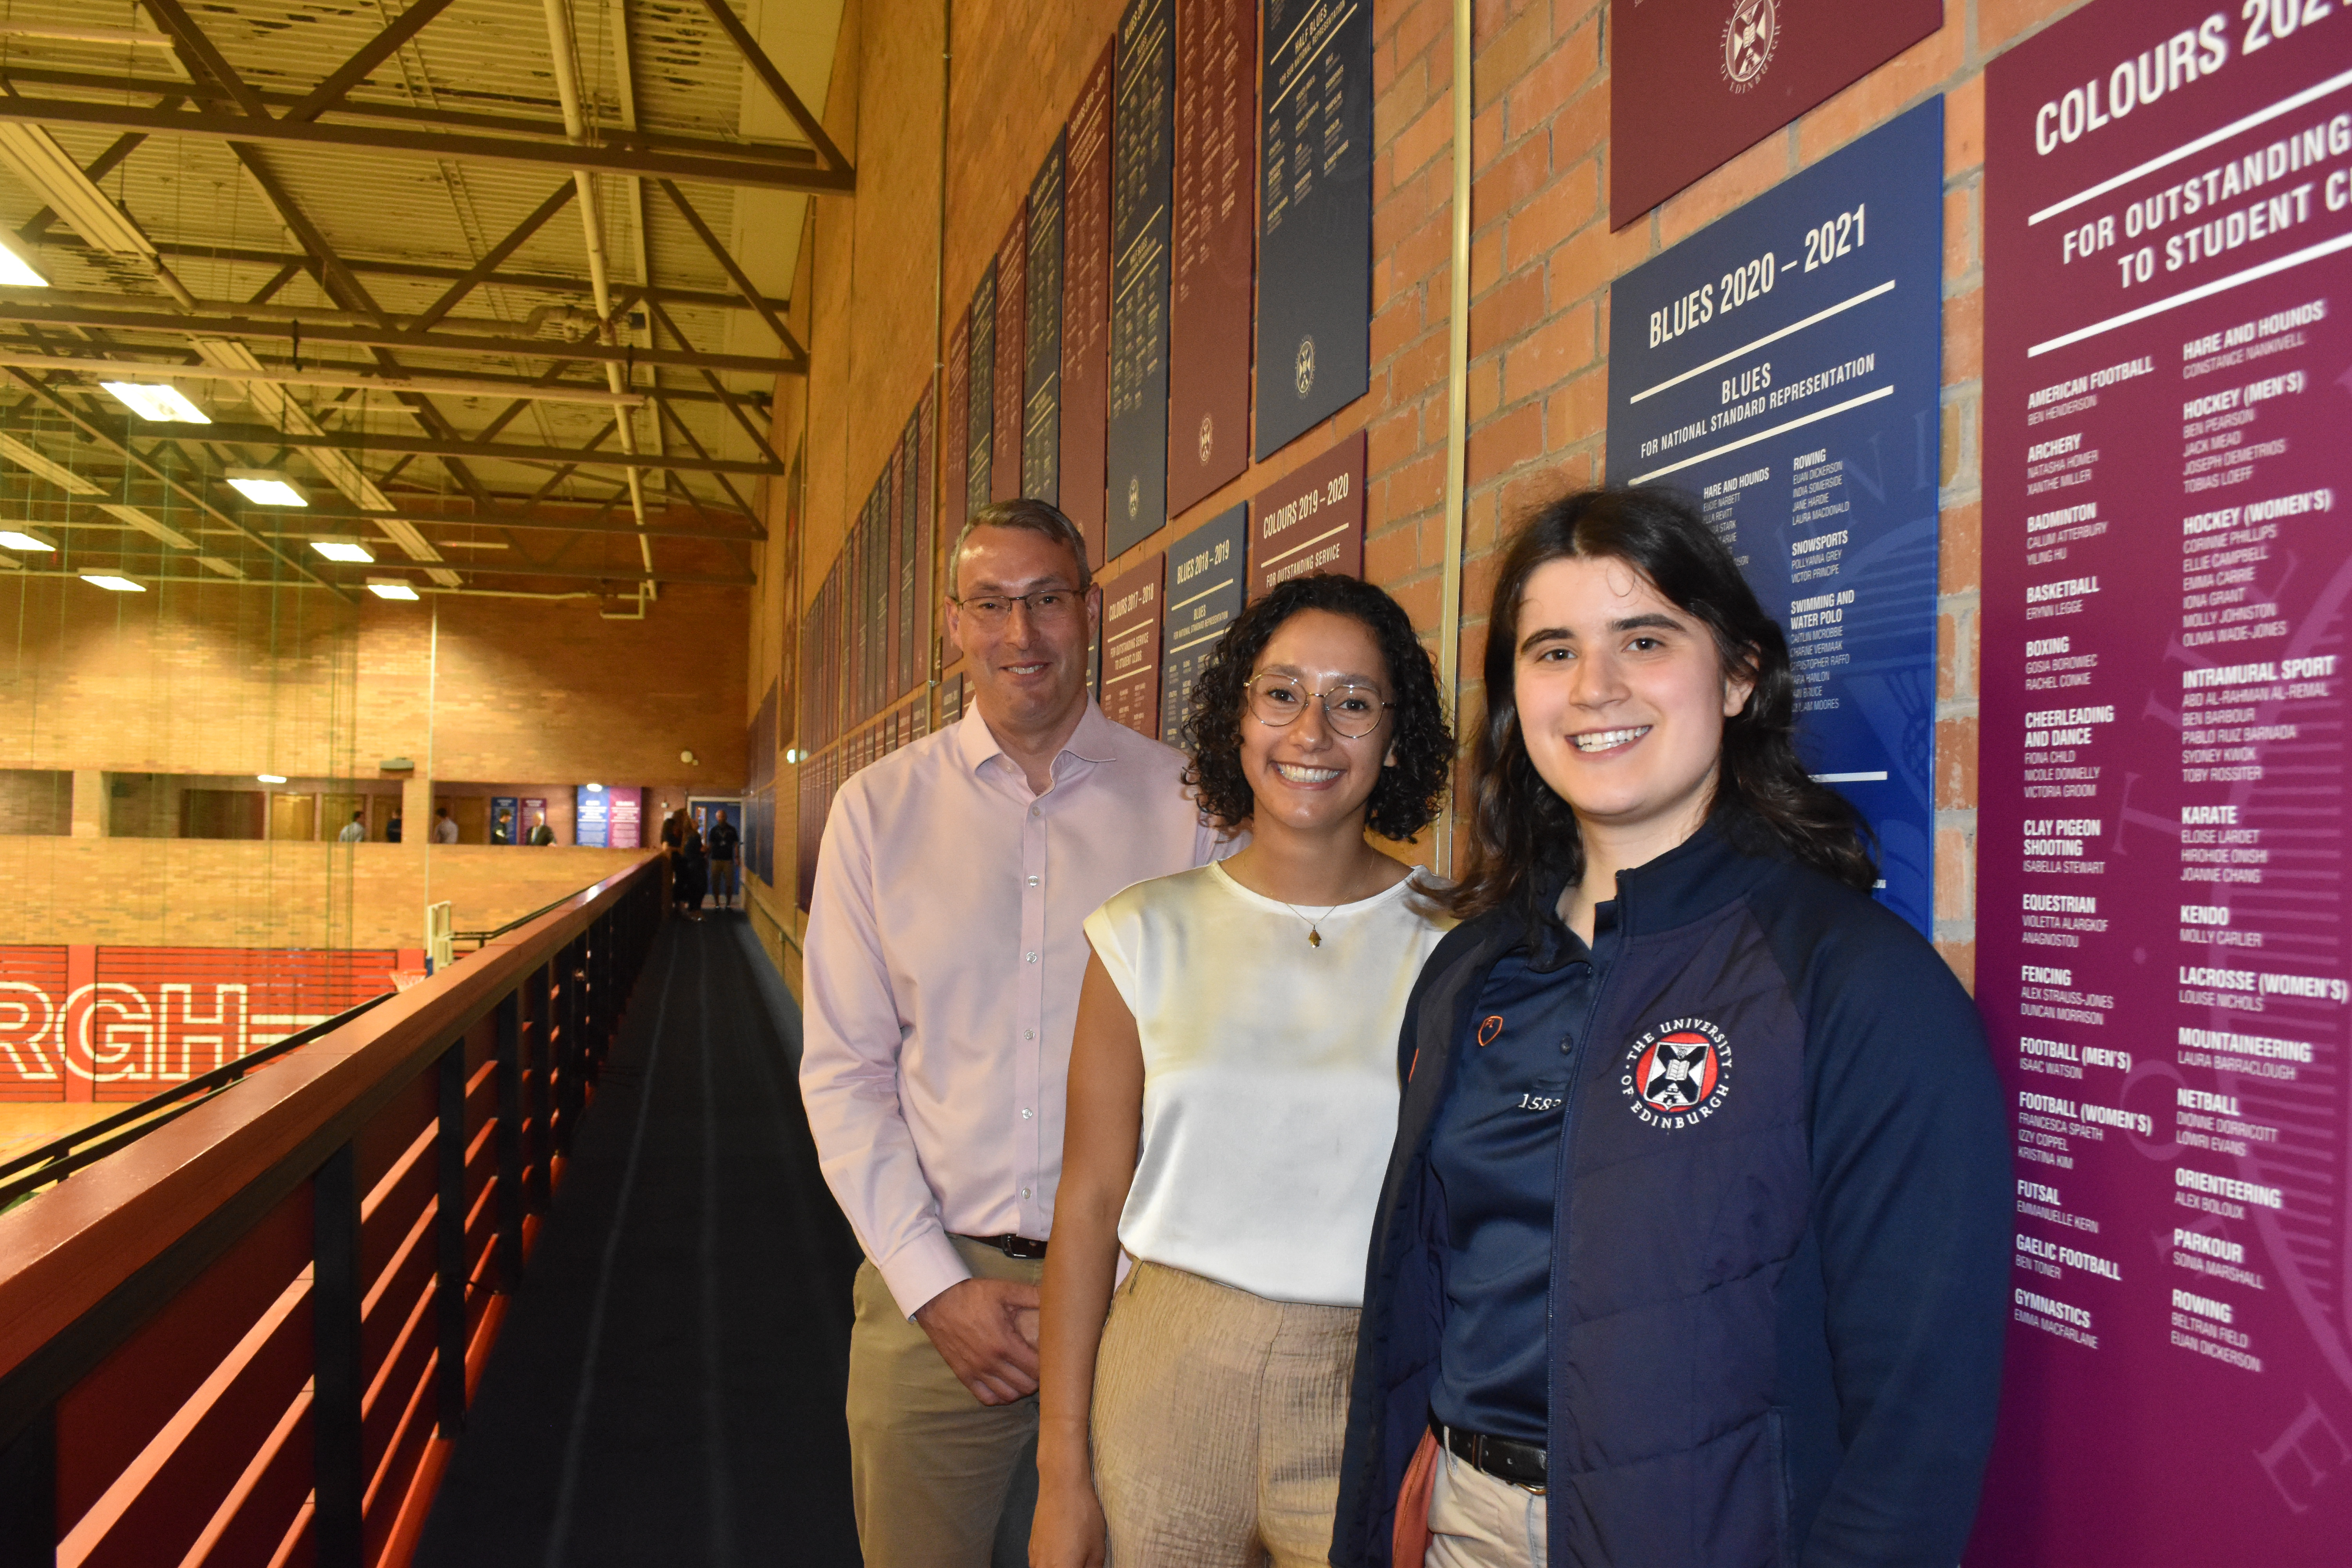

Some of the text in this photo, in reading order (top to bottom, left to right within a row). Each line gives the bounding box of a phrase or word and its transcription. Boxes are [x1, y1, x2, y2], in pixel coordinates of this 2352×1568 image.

[1295, 4, 1327, 54] HALF BLUES
[2036, 13, 2227, 156] COLOURS
[2063, 113, 2352, 264] FOR OUTSTANDING
[2118, 183, 2313, 289] TO STUDENT
[1650, 283, 1713, 349] BLUES
[1720, 252, 1775, 314] 2020
[1804, 203, 1865, 273] 2021
[2183, 297, 2326, 363] HARE AND HOUNDS
[1722, 361, 1771, 405] BLUES
[2028, 352, 2154, 410] AMERICAN FOOTBALL
[2183, 367, 2306, 422] HOCKEY (MEN'S)
[1641, 352, 1875, 459] FOR NATIONAL STANDARD REPRESENTATION
[1793, 447, 1826, 472] ROWING
[2027, 431, 2082, 464] ARCHERY
[1704, 466, 1769, 500] HARE AND HOUNDS
[1793, 460, 1843, 485] EUAN DICKERSON
[1793, 474, 1843, 499] INDIA SOMERSIDE
[1263, 501, 1297, 539] COLOURS
[1299, 489, 1318, 520] 2019
[1327, 472, 1349, 506] 2020
[1792, 492, 1829, 512] JANE HARDIE
[1792, 500, 1850, 526] LAURA MACDONALD
[2027, 500, 2098, 534] BADMINTON
[2183, 486, 2332, 537] HOCKEY (WOMEN'S)
[1791, 548, 1842, 570] POLLYANNA GREY
[1792, 529, 1848, 557] SNOWSPORTS
[2183, 543, 2270, 574] ELLIE CAMPBELL
[1177, 558, 1194, 584] BLUES
[1195, 550, 1209, 575] 2018
[1214, 539, 1229, 565] 2019
[1267, 543, 1340, 588] FOR OUTSTANDING SERVICE
[1791, 563, 1840, 584] VICTOR PRINCIPE
[1109, 597, 1127, 622] COLOURS
[1128, 591, 1138, 612] 2017
[1142, 583, 1154, 604] 2018
[1791, 589, 1855, 615] SWIMMING AND
[2026, 573, 2100, 604] BASKETBALL
[1194, 604, 1206, 621] BLUES
[1205, 610, 1228, 628] REPRESENTATION
[1790, 608, 1842, 630] WATER POLO
[1116, 638, 1136, 656] OUTSTANDING
[1136, 632, 1149, 647] SERVICE
[1830, 653, 1850, 666] RAFFO
[2025, 635, 2070, 659] BOXING
[2182, 653, 2336, 690] INTRAMURAL SPORT
[1813, 698, 1839, 711] MOORES
[2025, 704, 2115, 730] CHEERLEADING
[2024, 726, 2092, 749] AND DANCE
[2023, 818, 2102, 837] CLAY PIGEON
[2181, 804, 2238, 825] KARATE
[2023, 838, 2084, 857] SHOOTING
[2023, 860, 2106, 875] ISABELLA STEWART
[2022, 893, 2096, 914] EQUESTRIAN
[2180, 904, 2231, 926] KENDO
[2021, 964, 2072, 987] FENCING
[2180, 965, 2350, 1003] LACROSSE (WOMEN'S)
[1626, 1018, 1732, 1068] THE UNIVERSITY
[2020, 1036, 2132, 1073] FOOTBALL (MEN'S)
[2178, 1026, 2313, 1063] MOUNTAINEERING
[1621, 1075, 1729, 1129] OF EDINBURGH
[2019, 1090, 2153, 1136] FOOTBALL (WOMEN'S)
[2176, 1087, 2242, 1118] NETBALL
[2017, 1178, 2060, 1206] FUTSAL
[2175, 1167, 2283, 1210] ORIENTEERING
[2016, 1233, 2120, 1281] GAELIC FOOTBALL
[2173, 1227, 2244, 1265] PARKOUR
[2014, 1287, 2092, 1330] GYMNASTICS
[2172, 1287, 2233, 1325] ROWING
